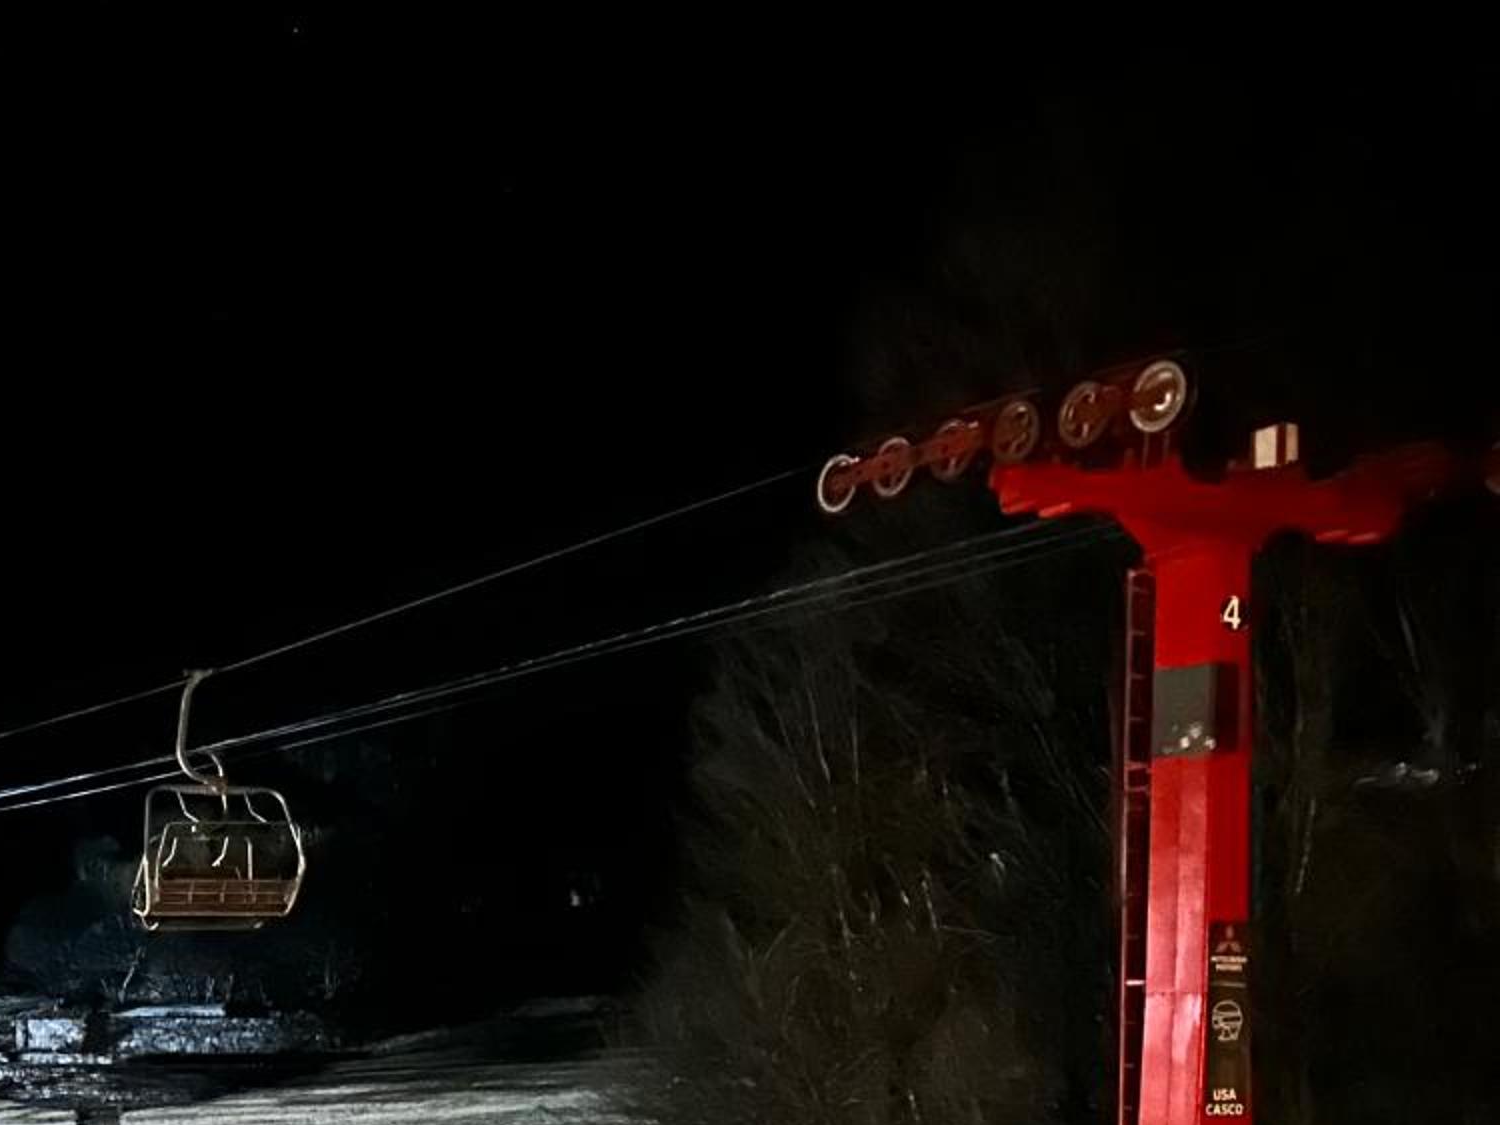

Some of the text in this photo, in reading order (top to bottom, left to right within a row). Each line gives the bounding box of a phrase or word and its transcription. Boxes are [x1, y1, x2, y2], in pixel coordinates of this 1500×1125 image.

[1222, 594, 1242, 631] 4
[1213, 1087, 1237, 1101] USA
[1205, 1103, 1244, 1116] CASCO
